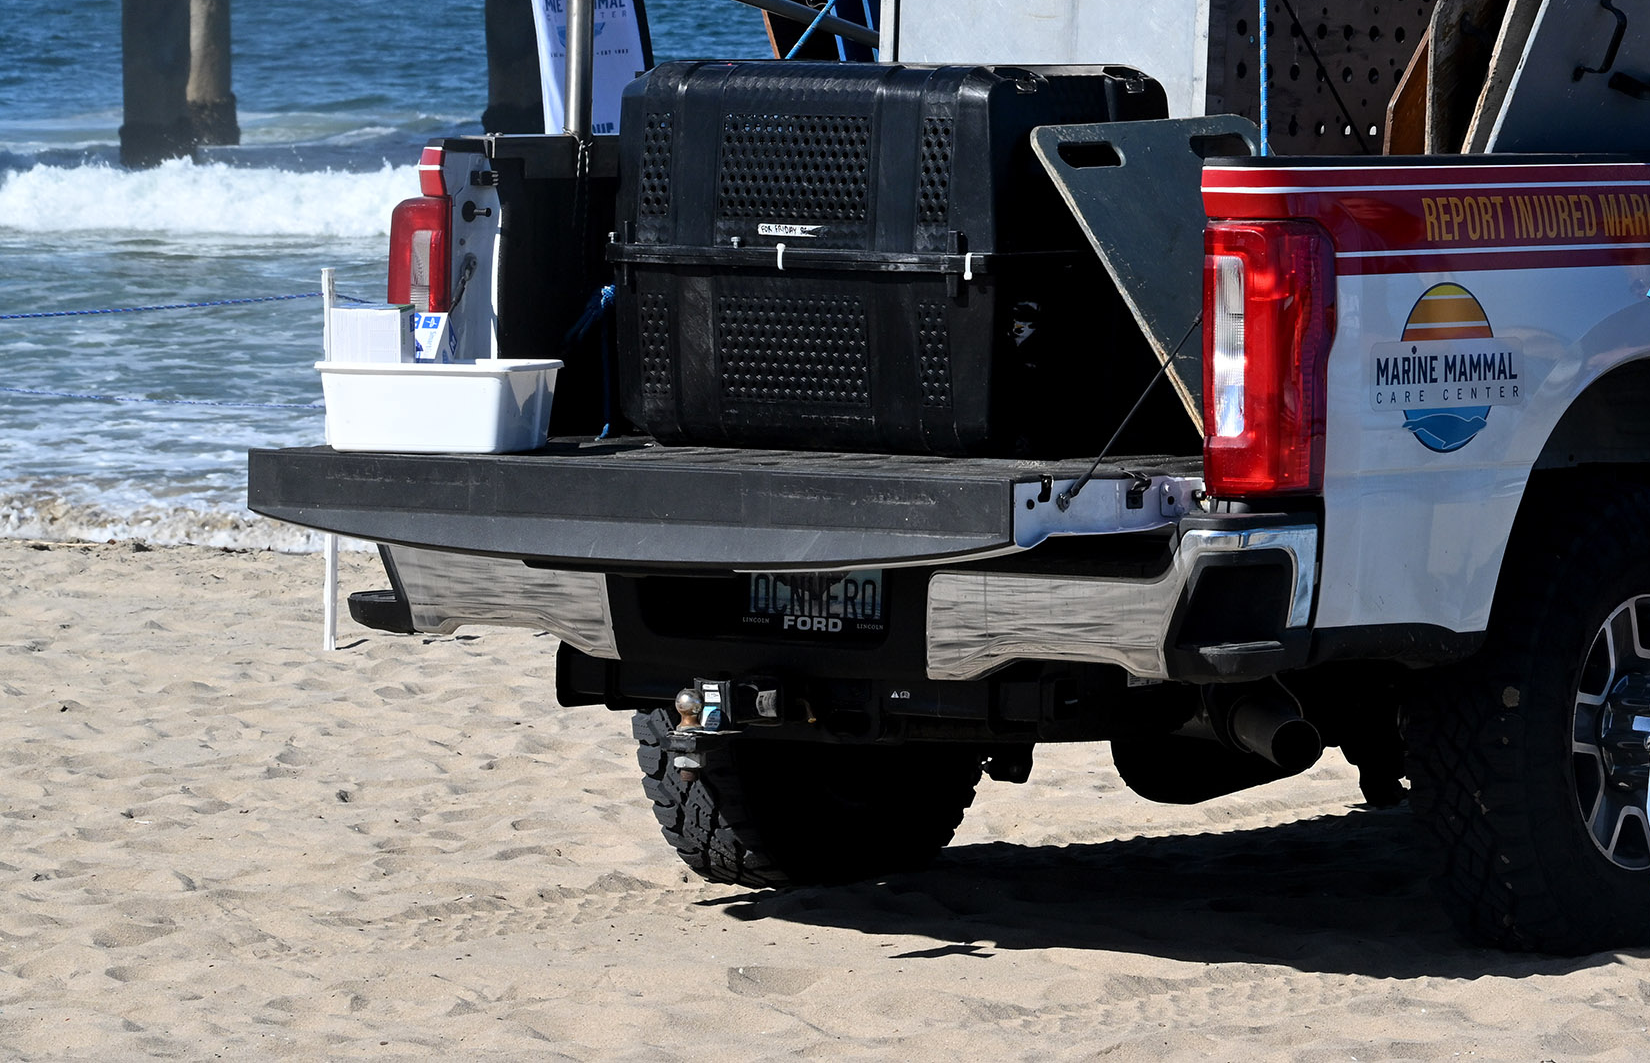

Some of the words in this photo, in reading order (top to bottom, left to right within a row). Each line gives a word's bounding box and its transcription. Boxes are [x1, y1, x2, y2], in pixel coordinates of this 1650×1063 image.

[1421, 195, 1505, 241] REPORT
[1509, 194, 1597, 239] INJURED
[760, 224, 773, 234] FOR
[774, 224, 797, 235] FRIDAY
[1376, 346, 1438, 385] MARINE
[1443, 352, 1518, 383] MAMMAL
[1376, 390, 1425, 404] CARE
[1443, 386, 1519, 401] CENTER
[742, 616, 770, 624] LINCOLN
[783, 615, 843, 633] FORD
